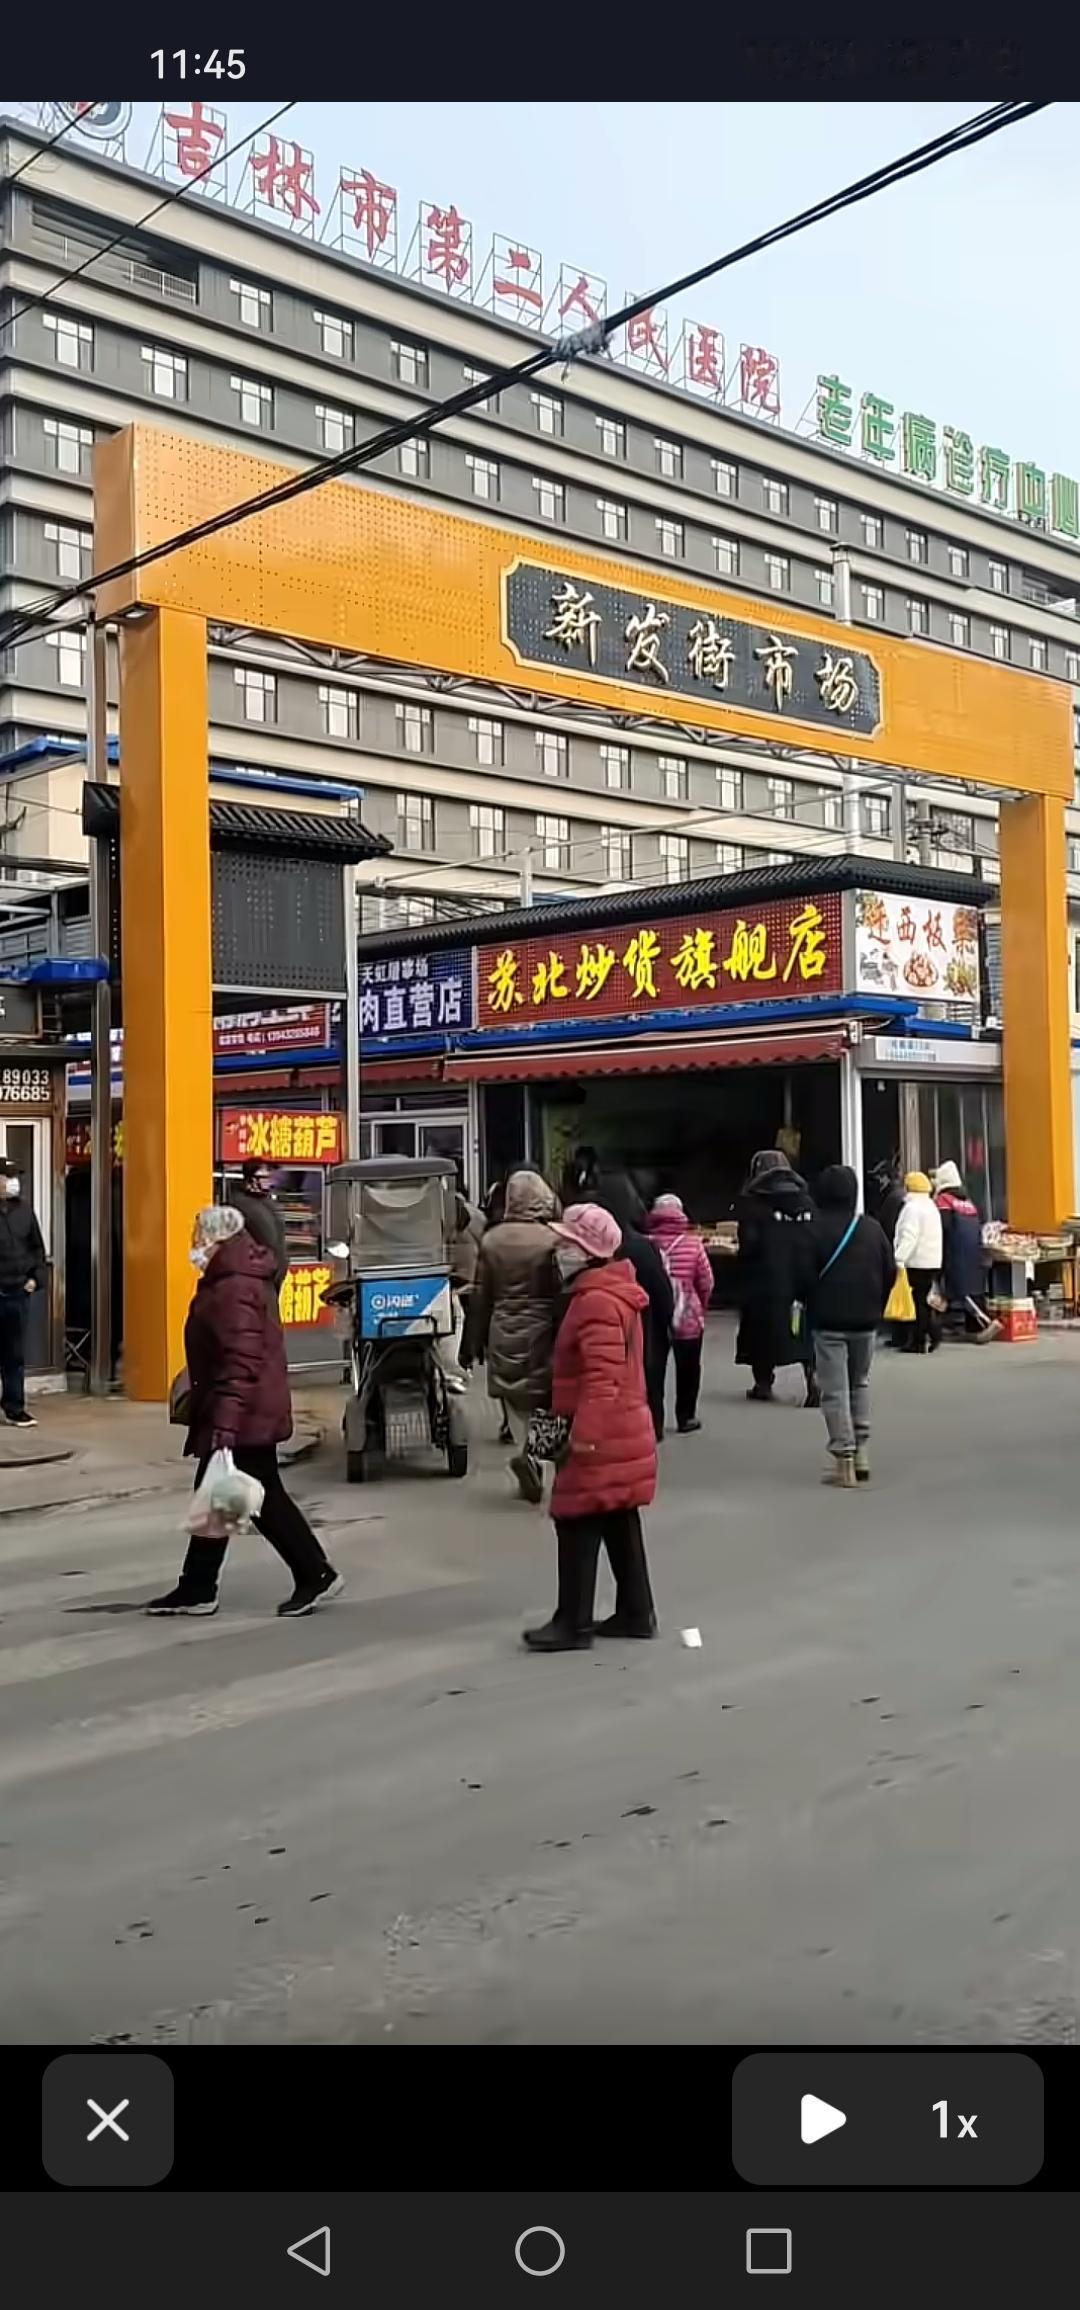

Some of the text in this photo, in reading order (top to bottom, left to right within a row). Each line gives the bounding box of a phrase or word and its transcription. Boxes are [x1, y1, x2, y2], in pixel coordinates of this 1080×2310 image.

[817, 374, 1080, 538] 老年病诊疗中心
[545, 581, 861, 715] 新发街市场
[359, 976, 463, 1033] 肉直营店
[487, 904, 828, 1013] 苏北炒货旗舰店
[247, 1113, 337, 1159] 冰糖葫芦
